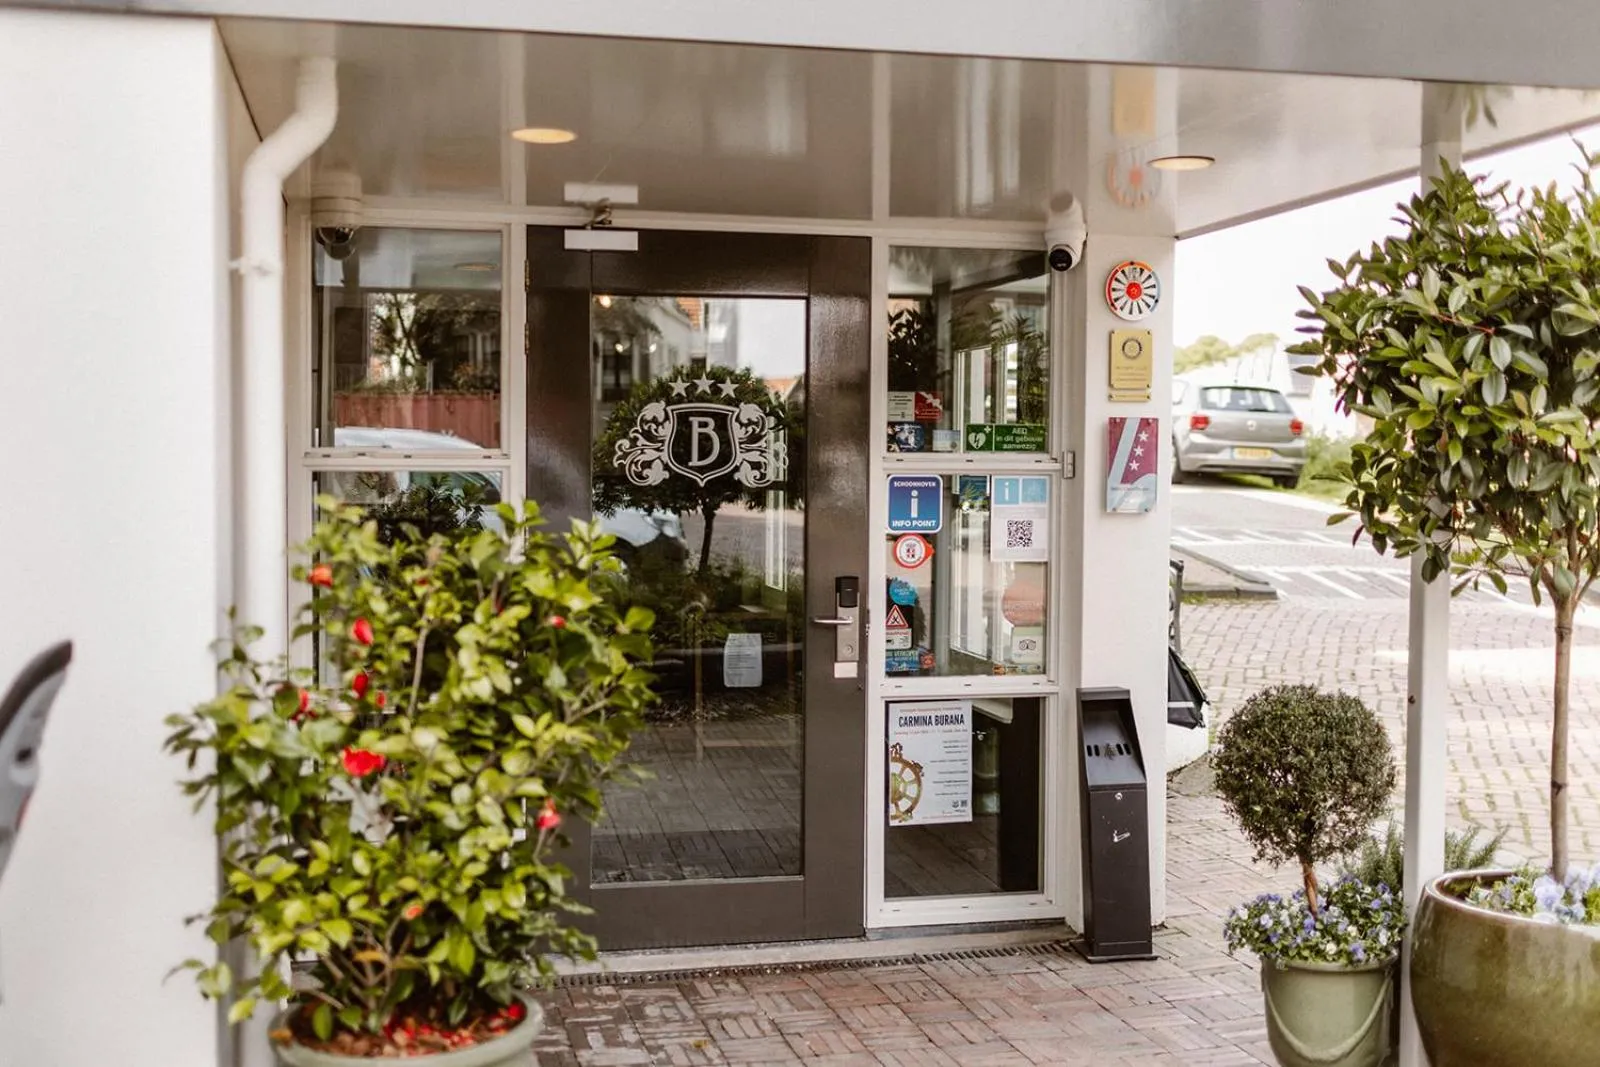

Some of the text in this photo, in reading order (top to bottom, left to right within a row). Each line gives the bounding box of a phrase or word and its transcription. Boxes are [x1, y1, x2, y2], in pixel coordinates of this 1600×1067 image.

[687, 416, 721, 467] B
[892, 519, 937, 527] INFO POINT
[898, 713, 965, 728] CARMINA BURANA
